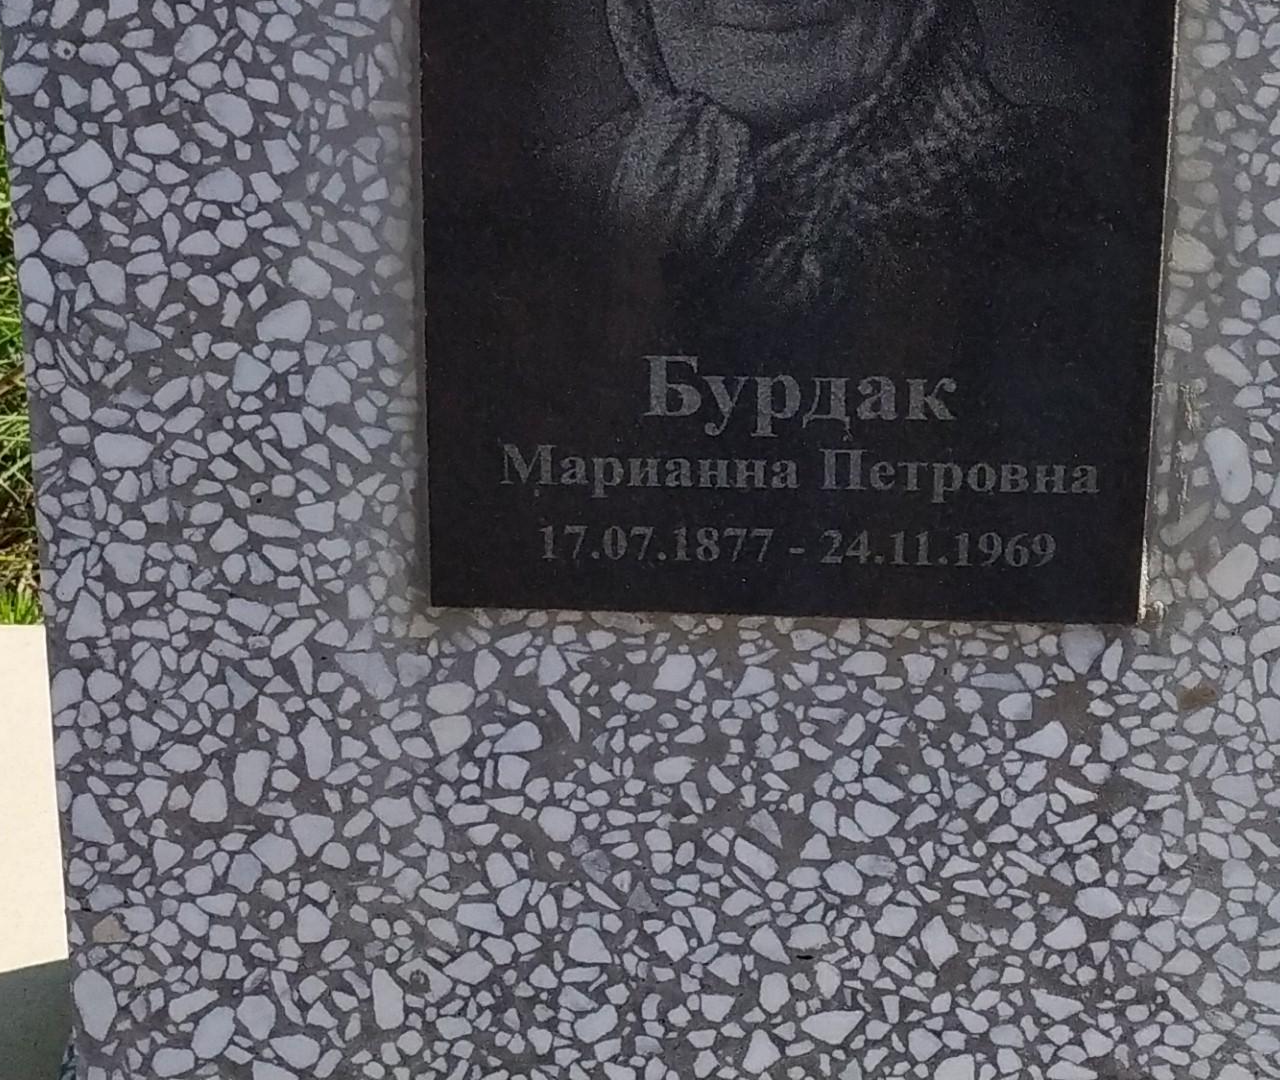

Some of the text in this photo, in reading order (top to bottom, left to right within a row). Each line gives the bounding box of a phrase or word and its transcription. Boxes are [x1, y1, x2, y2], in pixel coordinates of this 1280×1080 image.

[642, 354, 958, 437] Бурдак
[500, 443, 1100, 503] Марианна Петровна
[538, 525, 775, 563] 17.07.1877
[819, 529, 1056, 568] 24.11.1969
